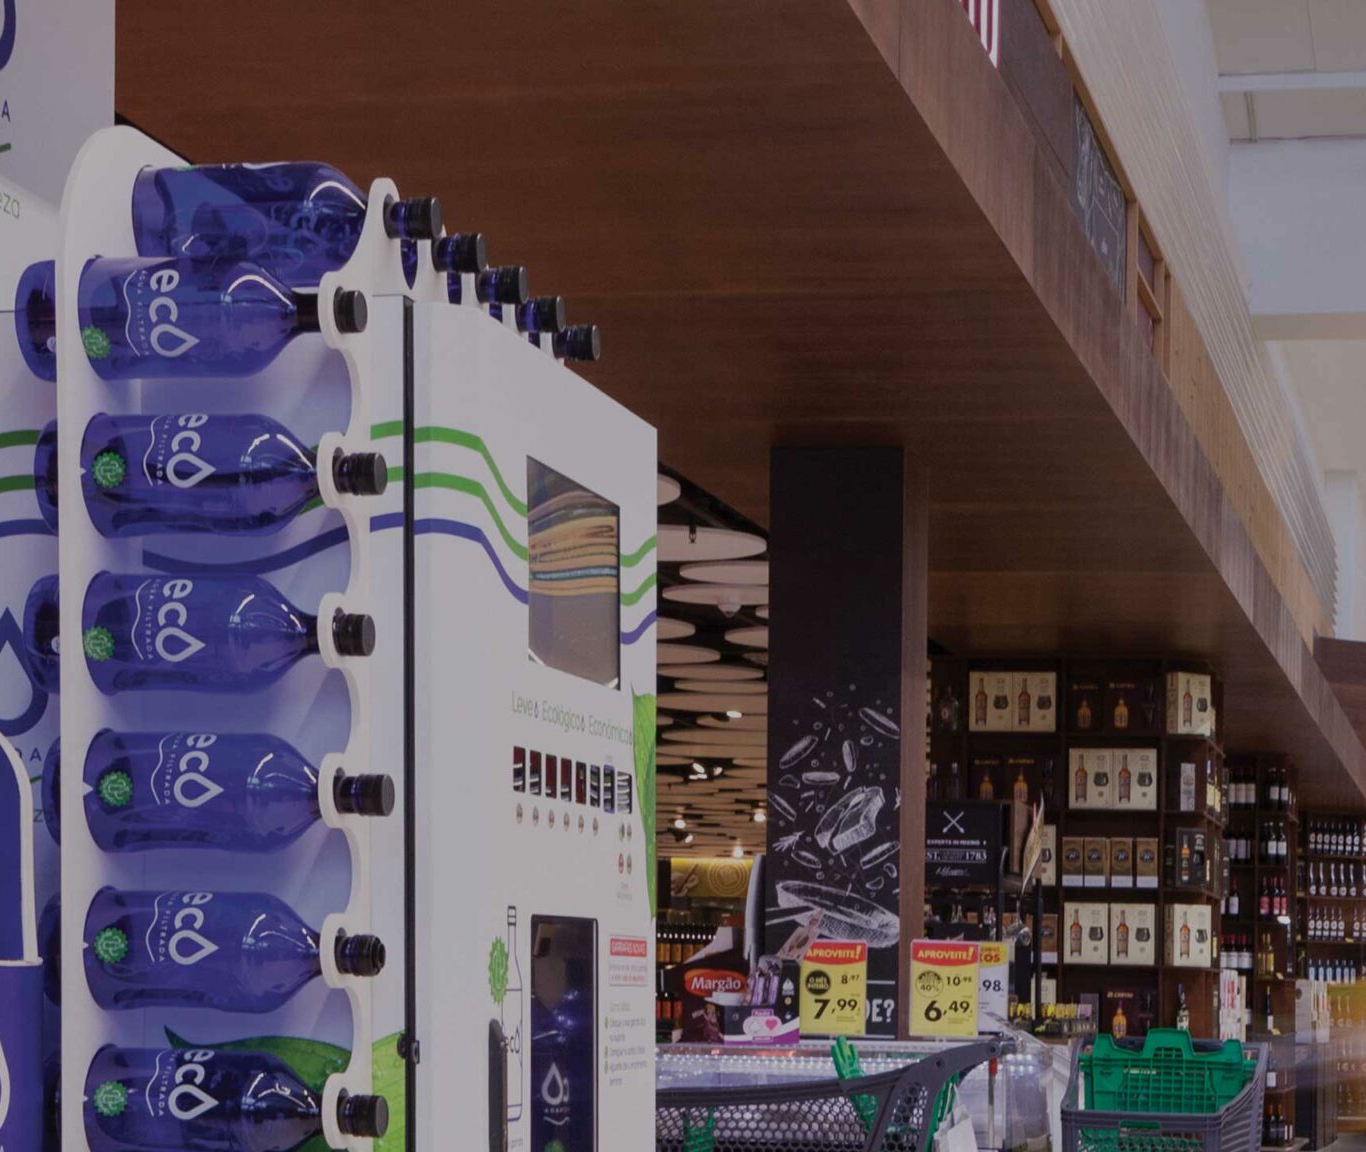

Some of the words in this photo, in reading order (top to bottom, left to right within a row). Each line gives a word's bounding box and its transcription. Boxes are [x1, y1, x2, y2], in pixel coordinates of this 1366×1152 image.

[918, 945, 975, 961] APROVEITE!
[691, 976, 741, 993] Margão
[813, 998, 858, 1020] 7,99
[924, 1000, 971, 1022] 6,49
